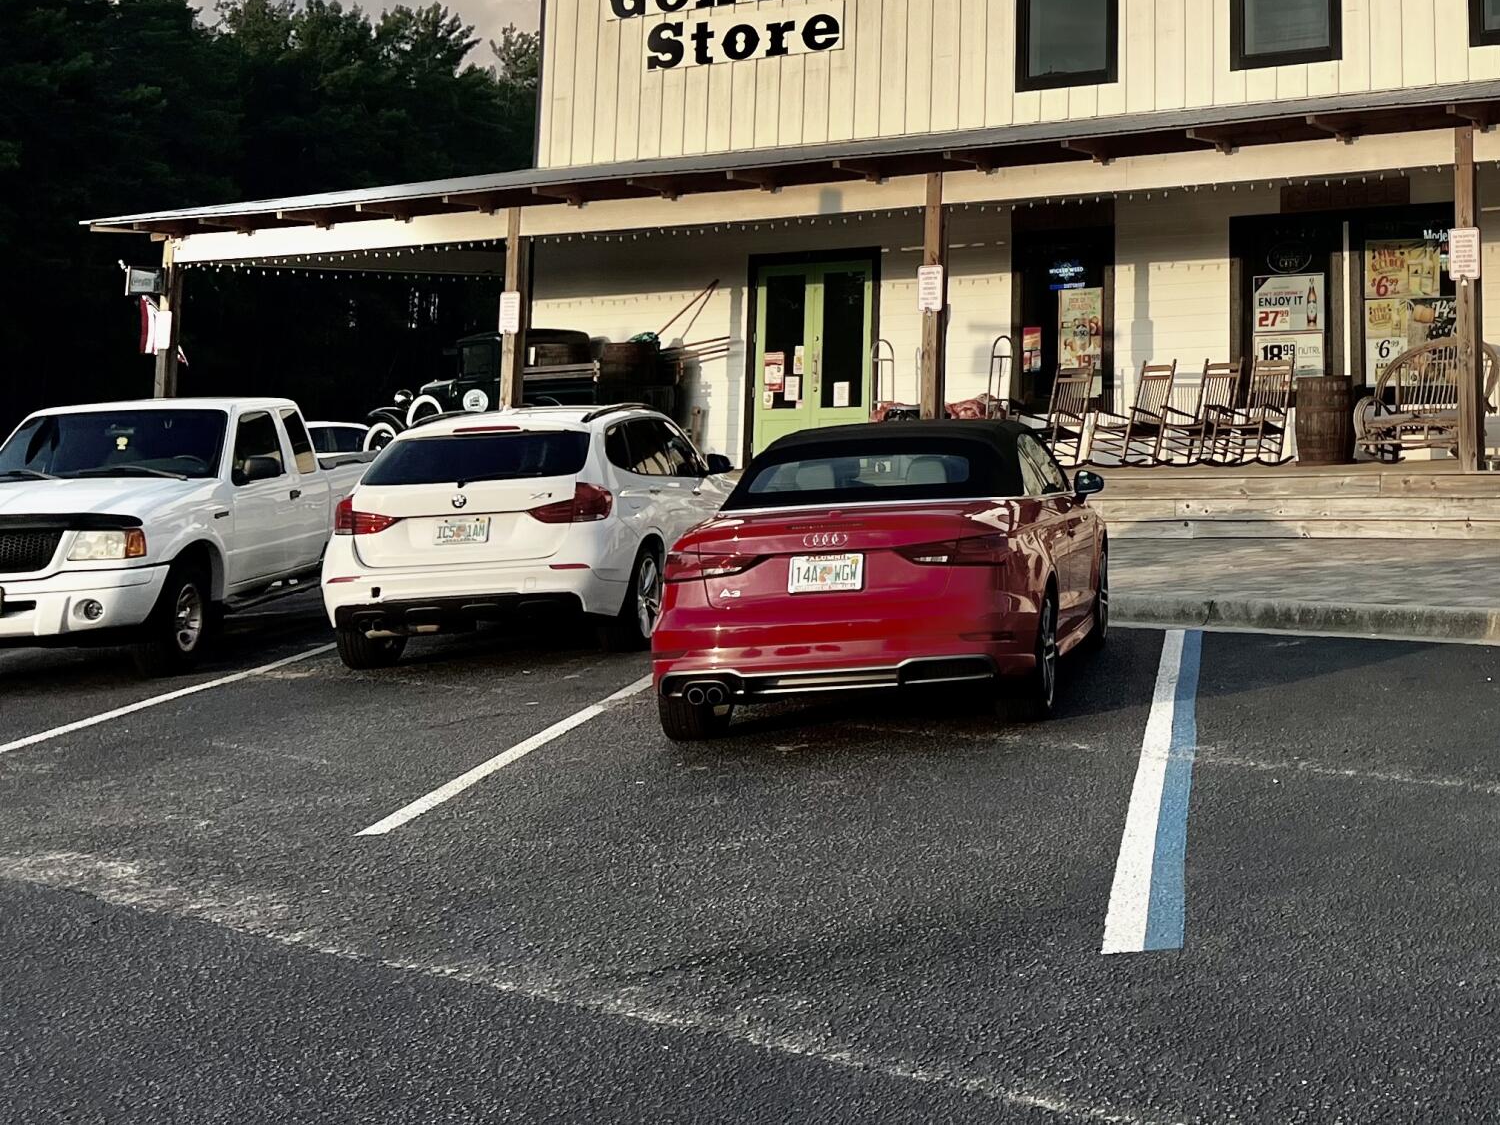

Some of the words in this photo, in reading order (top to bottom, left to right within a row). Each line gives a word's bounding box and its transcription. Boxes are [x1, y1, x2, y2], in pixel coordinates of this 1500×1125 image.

[647, 13, 841, 71] Store
[1258, 296, 1291, 307] ENJOY
[1294, 296, 1303, 305] IT
[529, 492, 553, 500] X1
[797, 565, 818, 583] 14A
[719, 588, 741, 598] A3
